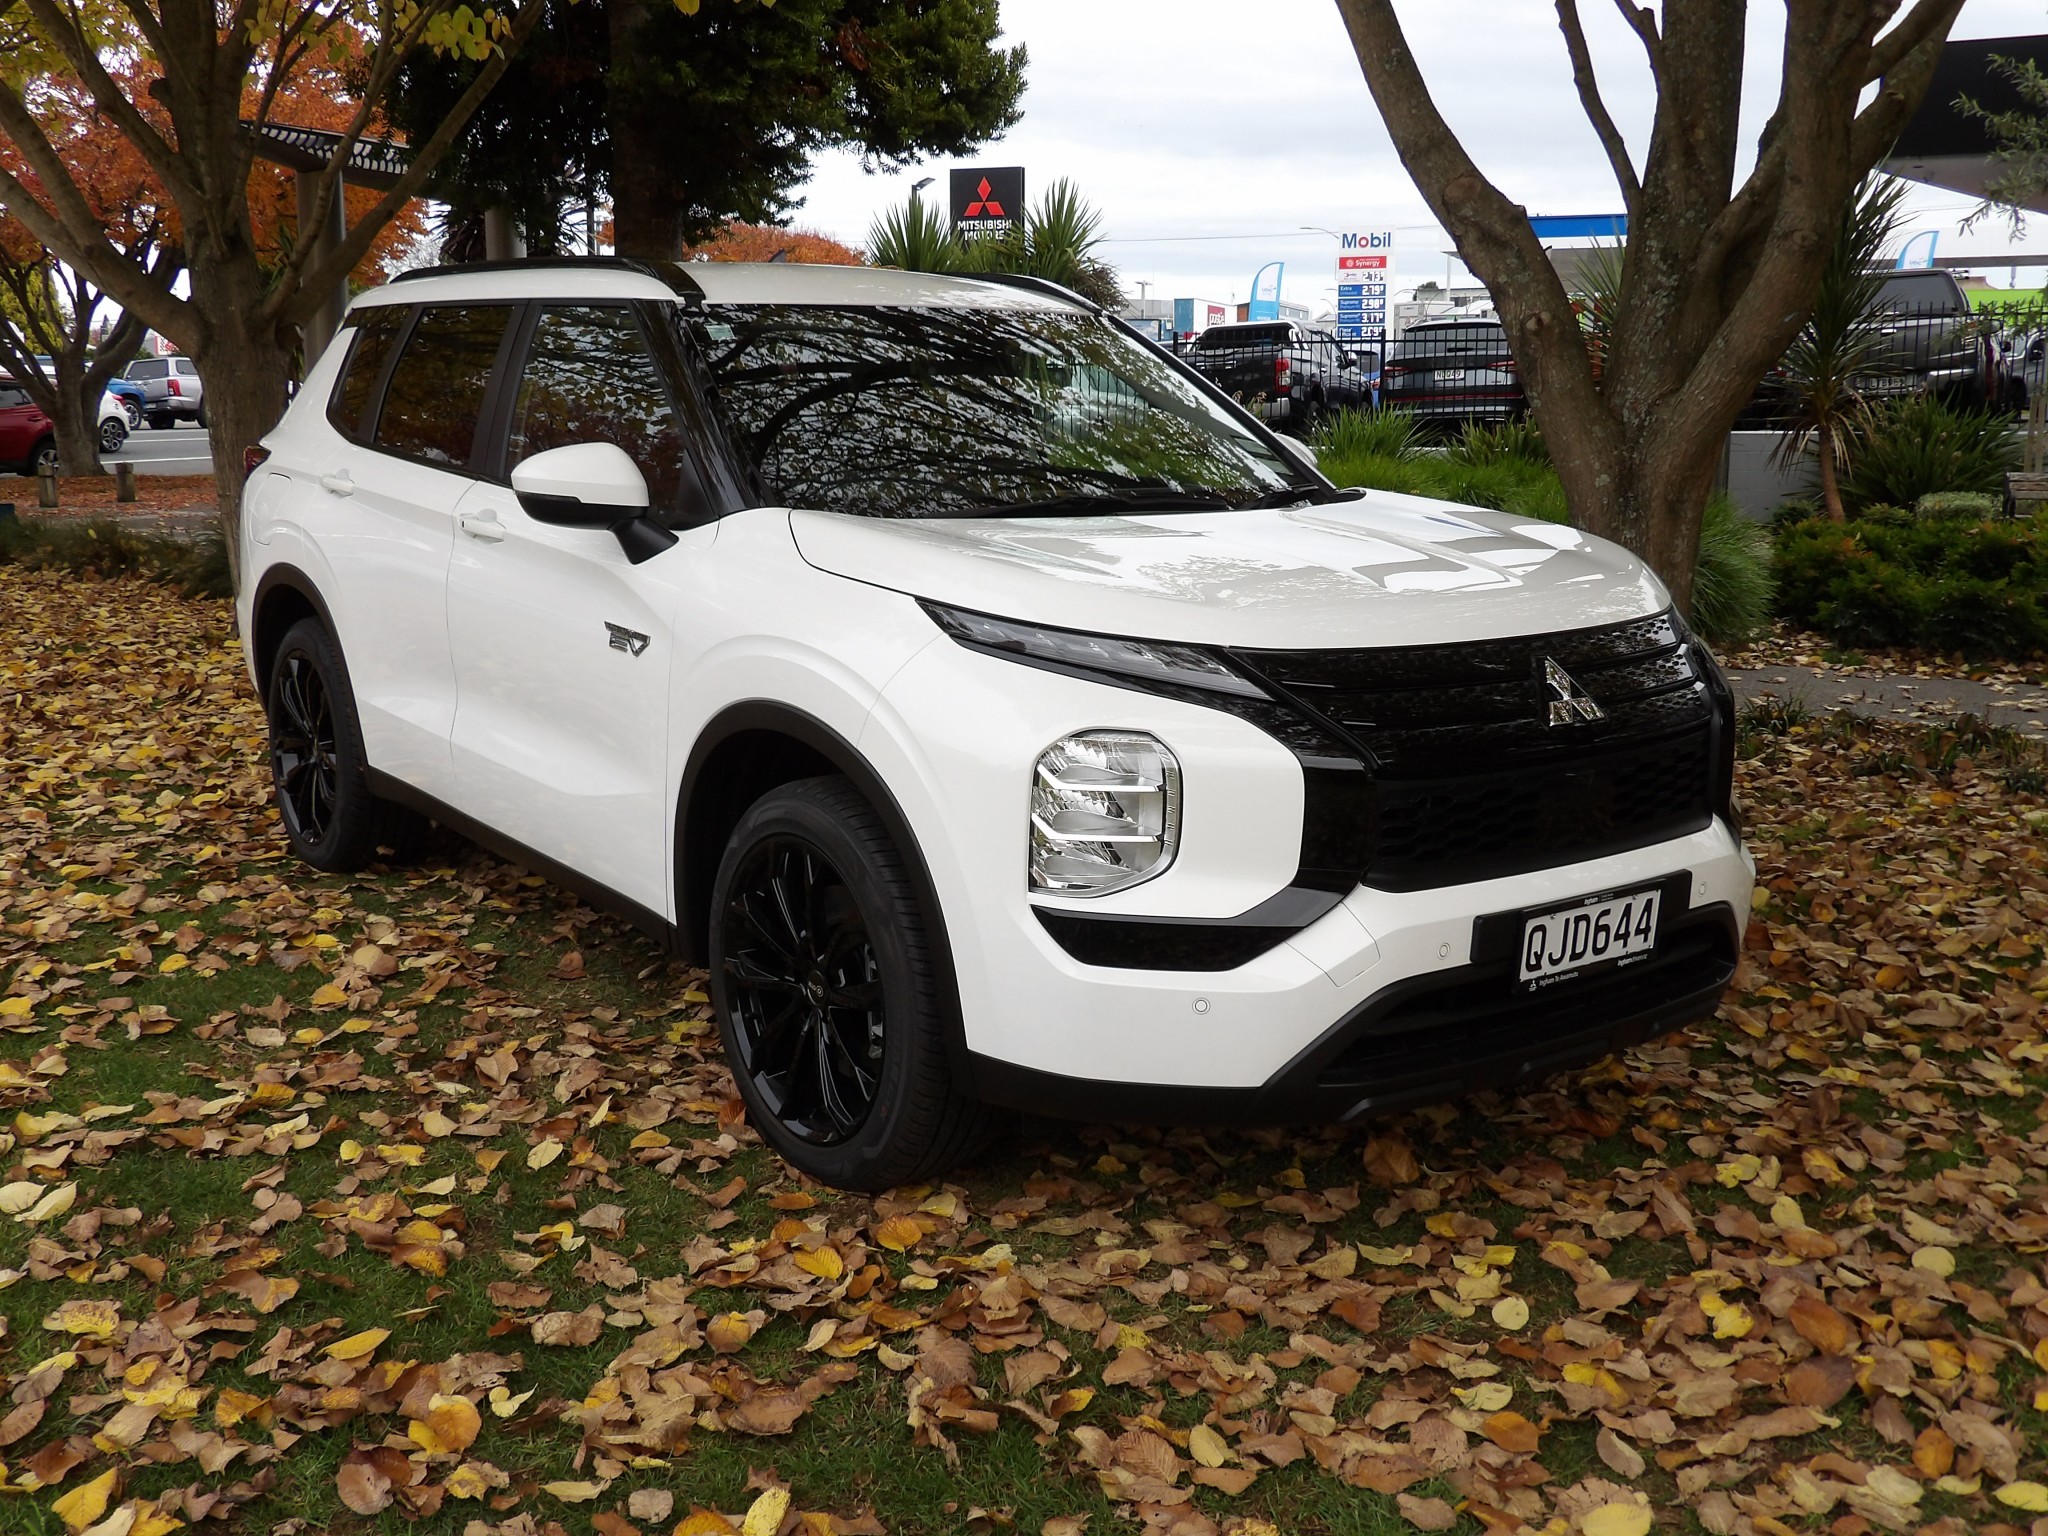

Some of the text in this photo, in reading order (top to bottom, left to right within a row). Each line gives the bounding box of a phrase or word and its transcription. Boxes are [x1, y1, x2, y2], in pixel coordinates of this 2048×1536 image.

[957, 219, 1012, 231] MITSUBISHI
[1341, 232, 1391, 249] Mobil
[1355, 260, 1380, 268] Synergy
[1525, 896, 1654, 972] QJD644
[1539, 977, 1555, 987] Ingham
